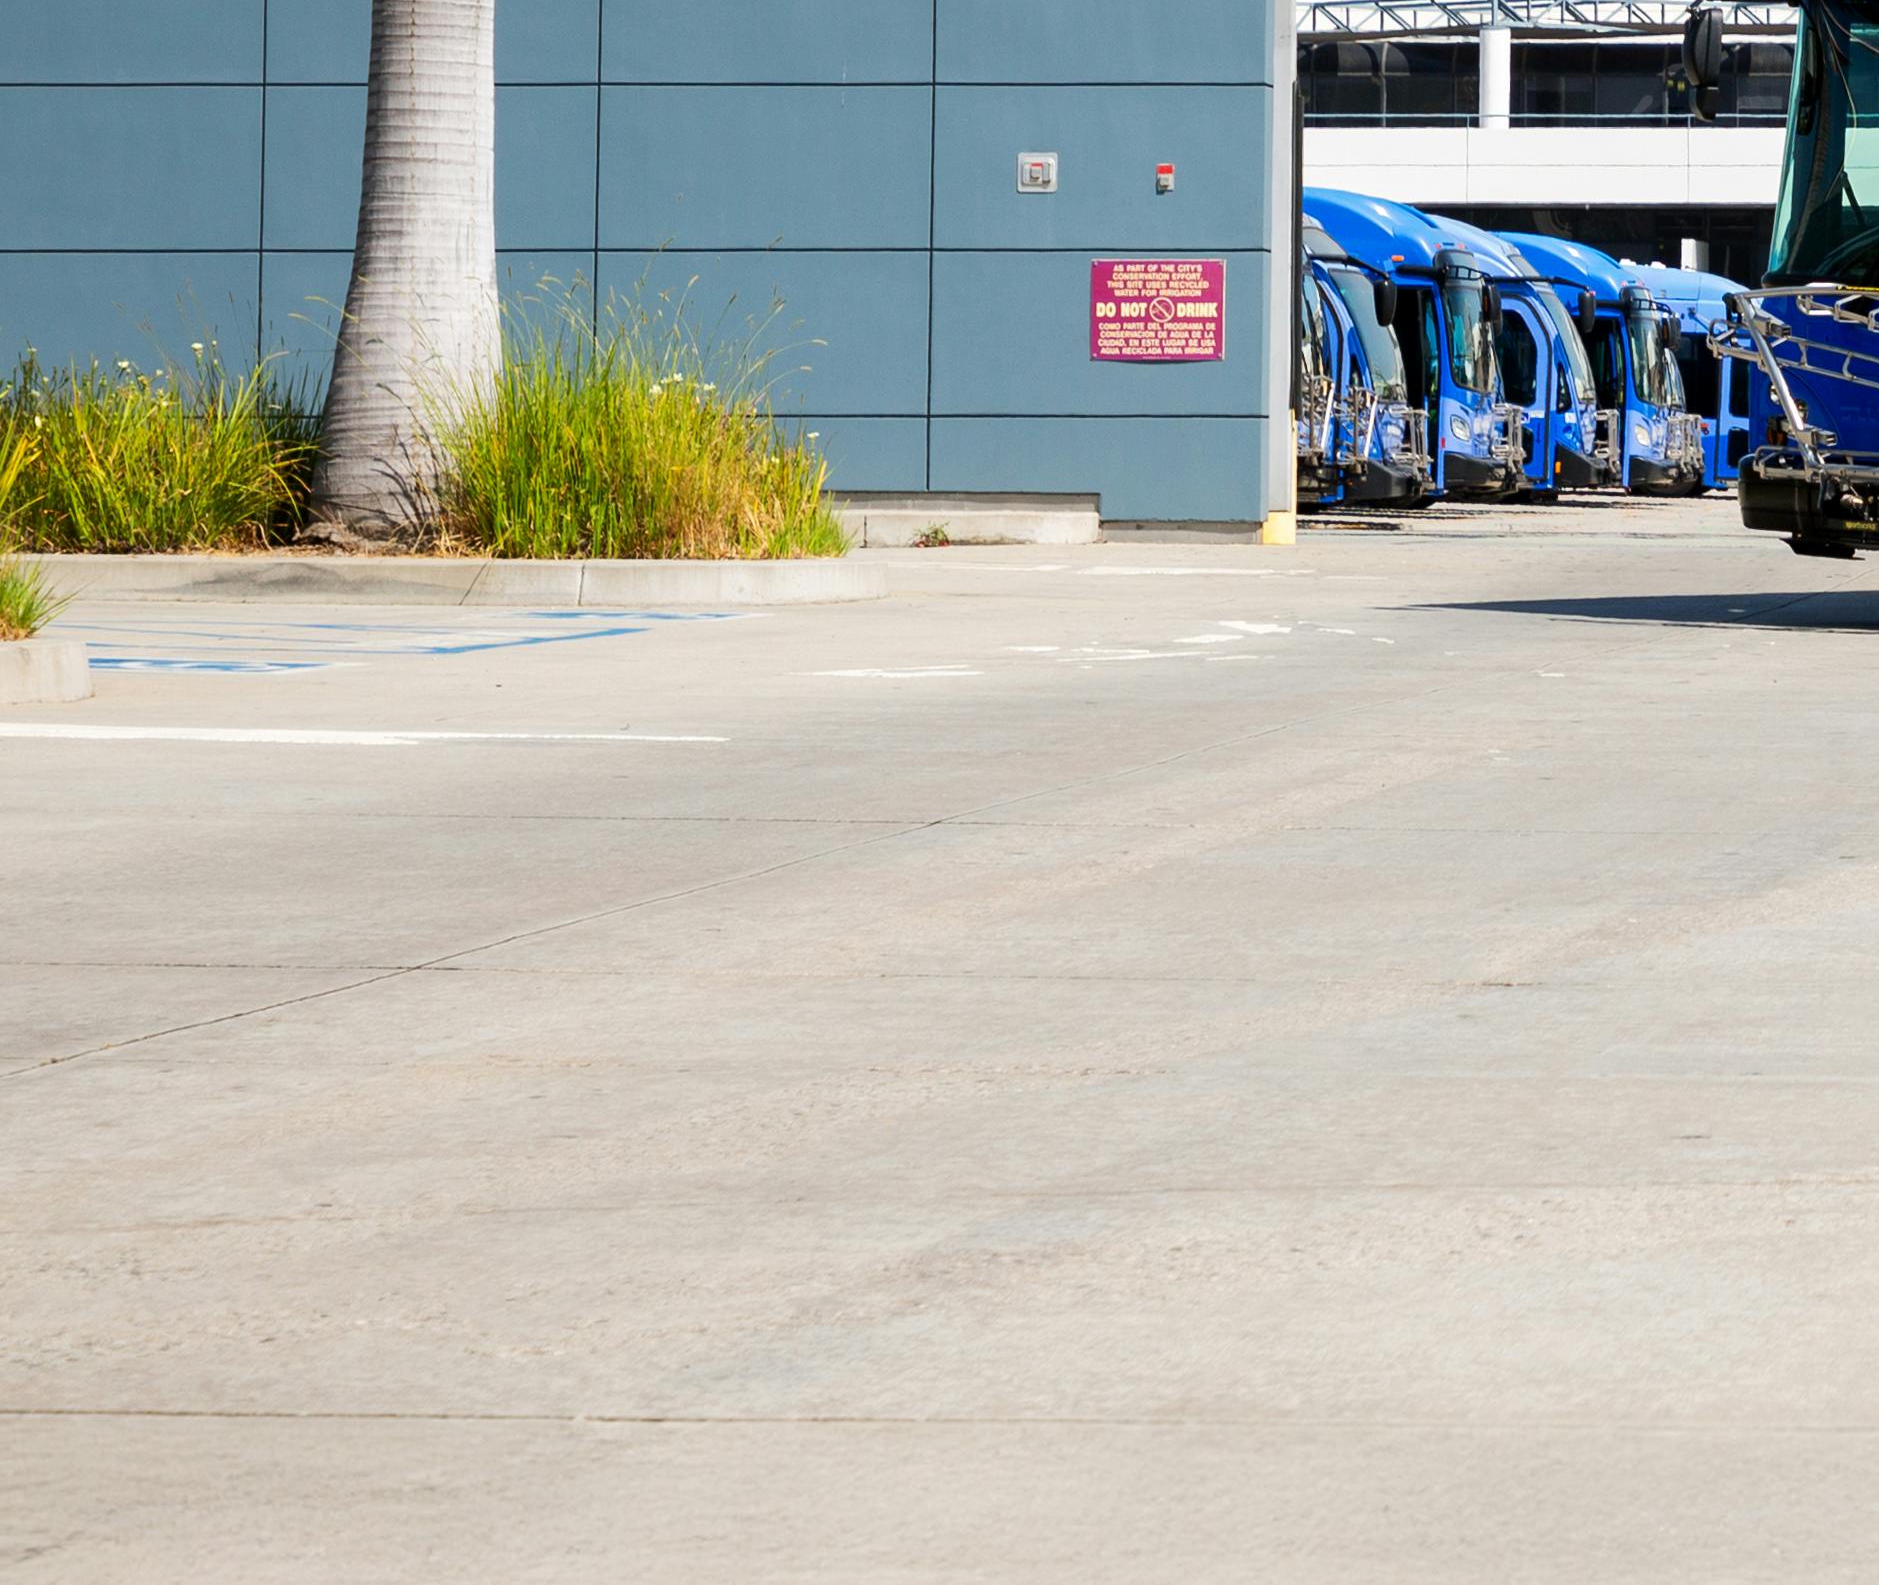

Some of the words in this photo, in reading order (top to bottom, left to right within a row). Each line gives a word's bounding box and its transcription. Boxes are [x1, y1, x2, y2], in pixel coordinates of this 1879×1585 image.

[1127, 264, 1145, 272] PART
[1147, 264, 1158, 272] OF
[1161, 264, 1175, 272] THE
[1096, 302, 1116, 317] DO
[1121, 302, 1147, 317] NOT
[1176, 302, 1218, 317] DRINK
